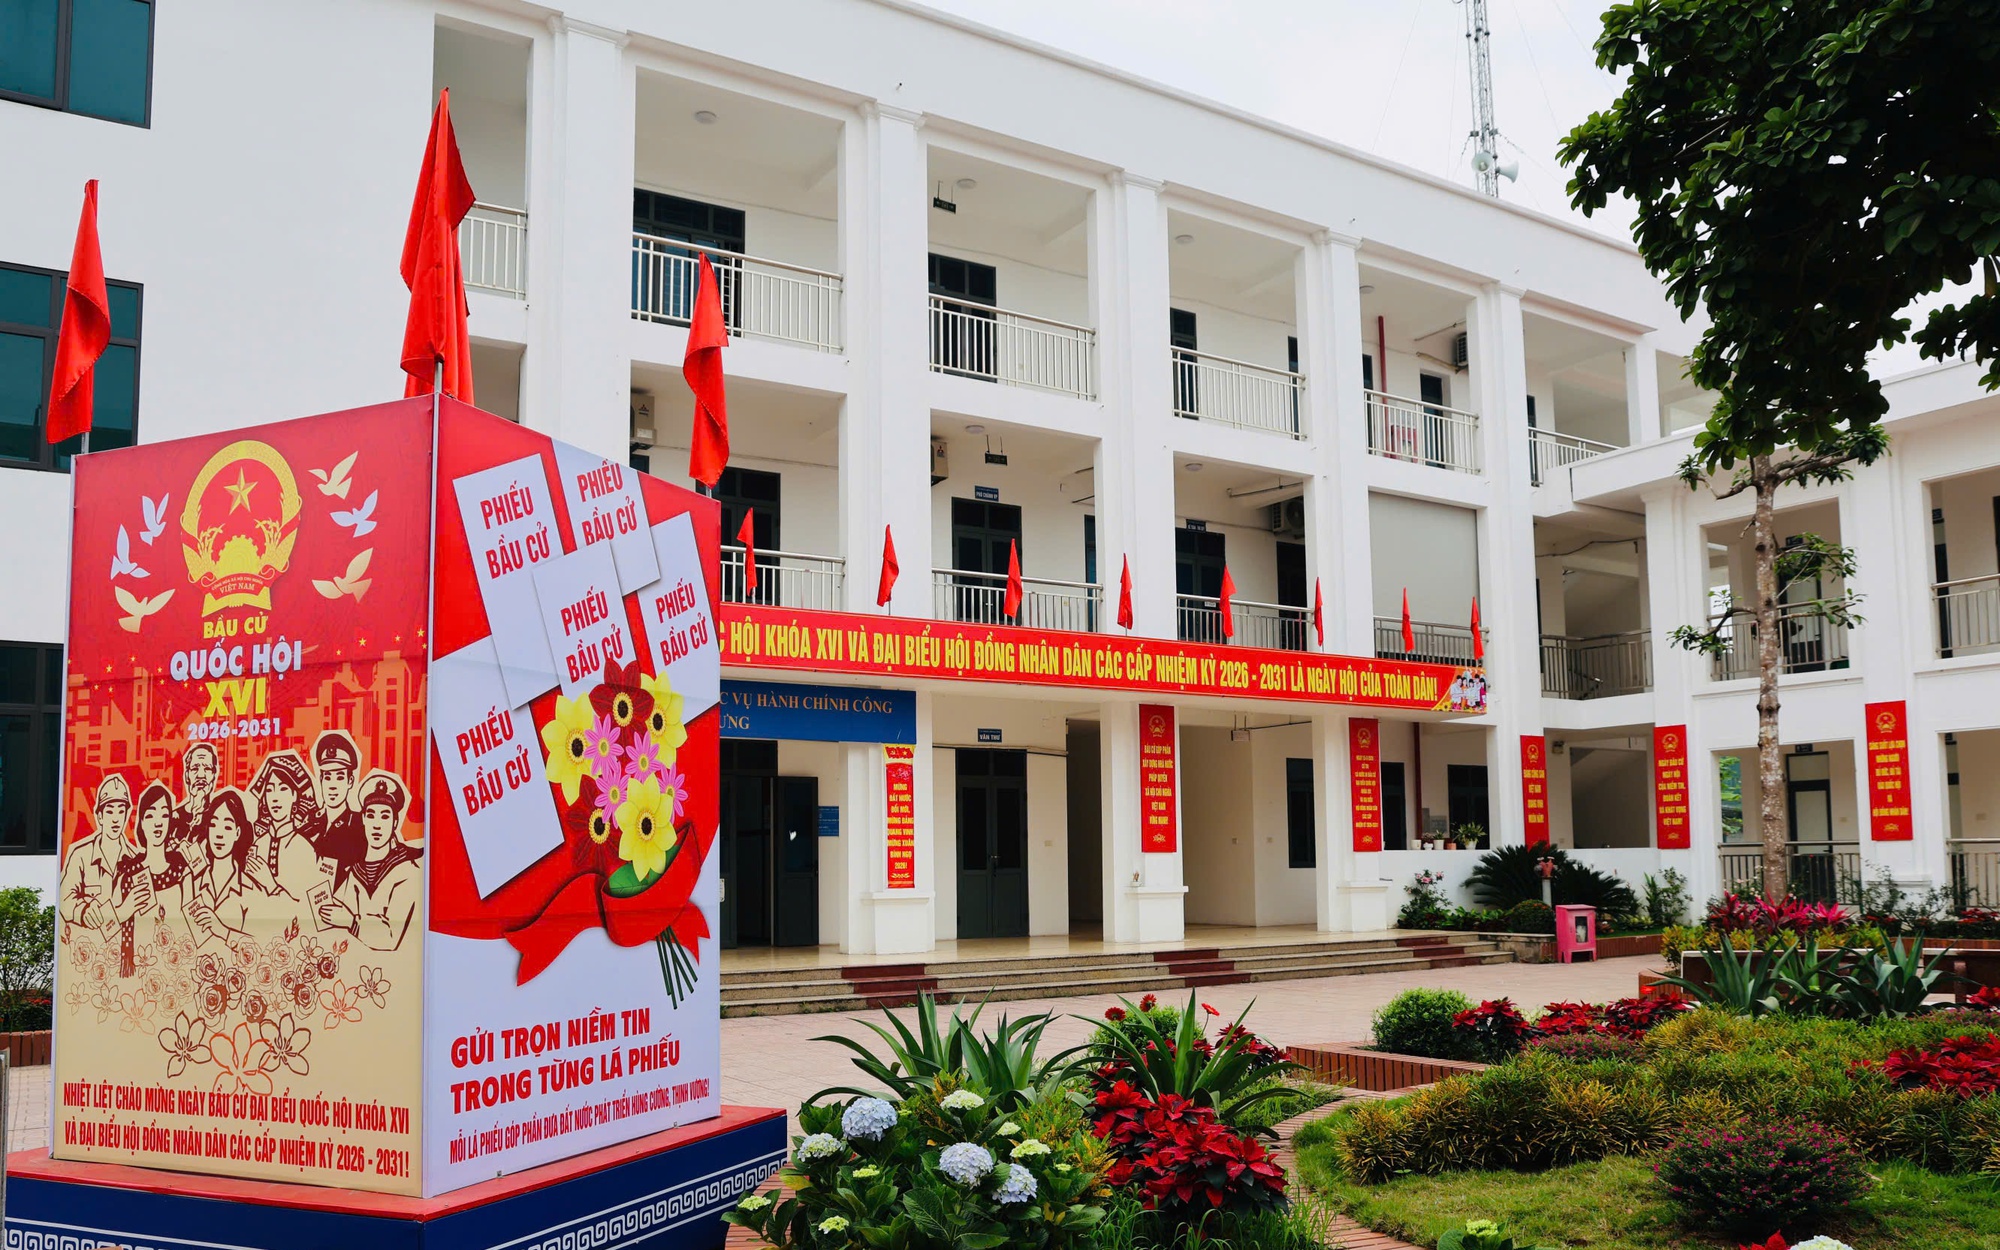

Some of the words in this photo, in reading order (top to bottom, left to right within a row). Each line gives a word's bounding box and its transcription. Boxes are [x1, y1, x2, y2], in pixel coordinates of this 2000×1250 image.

[480, 480, 535, 529] PHIẾU
[582, 505, 615, 546] BẦU
[616, 495, 638, 533] CỬ
[486, 536, 523, 580] BẦU
[526, 521, 552, 563] CỬ
[220, 584, 237, 593] VIỆT
[238, 583, 255, 591] NAM
[561, 586, 609, 636] PHIẾU
[655, 578, 695, 623] PHIẾU
[203, 614, 238, 639] BẦU
[244, 611, 268, 633] CỬ
[659, 625, 689, 666] BẦU
[690, 612, 708, 650] CỬ
[170, 639, 243, 681] QUỐC
[252, 636, 302, 682] HỘI
[566, 638, 601, 683] BẦU
[603, 624, 624, 662] CỬ
[730, 616, 760, 663] HỘI
[766, 614, 812, 660] KHÓA
[816, 628, 843, 661] XVI
[848, 625, 868, 663] VÀ
[873, 634, 900, 672] ĐẠI
[906, 624, 941, 668] BIỂU
[945, 634, 970, 676] HỘI
[975, 631, 1014, 672] ĐỒNG
[1019, 640, 1059, 675] NHÂN
[1063, 639, 1091, 678] DÂN
[1095, 651, 1123, 680] CÁC
[1126, 644, 1152, 681] CẤP
[1156, 652, 1197, 691] NHIỆM
[1201, 653, 1216, 686] KỲ
[1220, 660, 1248, 689] 2026
[1260, 662, 1287, 691] 2031
[1291, 659, 1304, 692] LÀ
[1308, 664, 1336, 694] NGÀY
[1340, 665, 1358, 697] HỘI
[1360, 662, 1382, 697] CỦA
[1385, 667, 1411, 700] TOÀN
[1413, 671, 1438, 702] DÂN!
[203, 678, 266, 718] XVI
[732, 692, 752, 710] VỤ
[757, 690, 798, 709] HÀNH
[803, 691, 849, 712] CHÍNH
[853, 696, 892, 714] CÔNG
[187, 717, 281, 740] 2026-2031
[456, 705, 515, 764] PHIẾU
[462, 758, 504, 816] BẦU
[505, 744, 531, 789] CỬ
[451, 1026, 494, 1068] GỬI
[502, 1022, 560, 1059] TRỌN
[568, 1006, 616, 1047] NIỀM
[621, 1008, 650, 1036] TIN
[451, 1069, 531, 1114] TRONG
[538, 1057, 594, 1095] TỪNG
[601, 1046, 623, 1082] LÁ
[629, 1033, 680, 1075] PHIẾU
[64, 1079, 90, 1113] NHIỆT
[94, 1079, 112, 1113] LIỆT
[116, 1082, 142, 1112] CHÀO
[145, 1086, 174, 1114] MỪNG
[178, 1087, 205, 1116] NGÀY
[209, 1084, 229, 1119] BẦU
[232, 1084, 249, 1120] CỬ
[250, 1098, 268, 1127] ĐẠI
[271, 1087, 296, 1124] BIỂU
[300, 1090, 329, 1128] QUỐC
[333, 1098, 352, 1137] HỘI
[356, 1098, 387, 1133] KHÓA
[390, 1106, 409, 1134] XVI
[450, 1128, 466, 1164] MỖI
[468, 1135, 478, 1160] LÁ
[480, 1121, 503, 1156] PHIẾU
[505, 1123, 520, 1150] GÓP
[522, 1112, 542, 1145] PHẦN
[543, 1112, 558, 1140] ĐƯA
[560, 1104, 573, 1136] ĐẤT
[575, 1099, 593, 1131] NƯỚC
[595, 1098, 611, 1126] PHÁT
[612, 1088, 630, 1122] TRIỂN
[632, 1093, 648, 1116] HÙNG
[650, 1083, 671, 1113] CƯỜNG,
[672, 1084, 689, 1110] THỊNH
[690, 1078, 710, 1105] VƯỢNG!
[65, 1120, 77, 1145] VÀ
[79, 1122, 95, 1152] ĐẠI
[99, 1113, 120, 1148] BIỂU
[124, 1122, 139, 1155] HỘI
[143, 1119, 170, 1153] ĐỒNG
[173, 1125, 202, 1156] NHÂN
[205, 1128, 227, 1159] DÂN
[230, 1128, 252, 1162] CÁC
[255, 1128, 275, 1164] CẤP
[279, 1138, 315, 1172] NHIỆM
[319, 1141, 333, 1170] KỲ
[336, 1144, 364, 1172] 2026
[376, 1148, 409, 1178] 2031!
